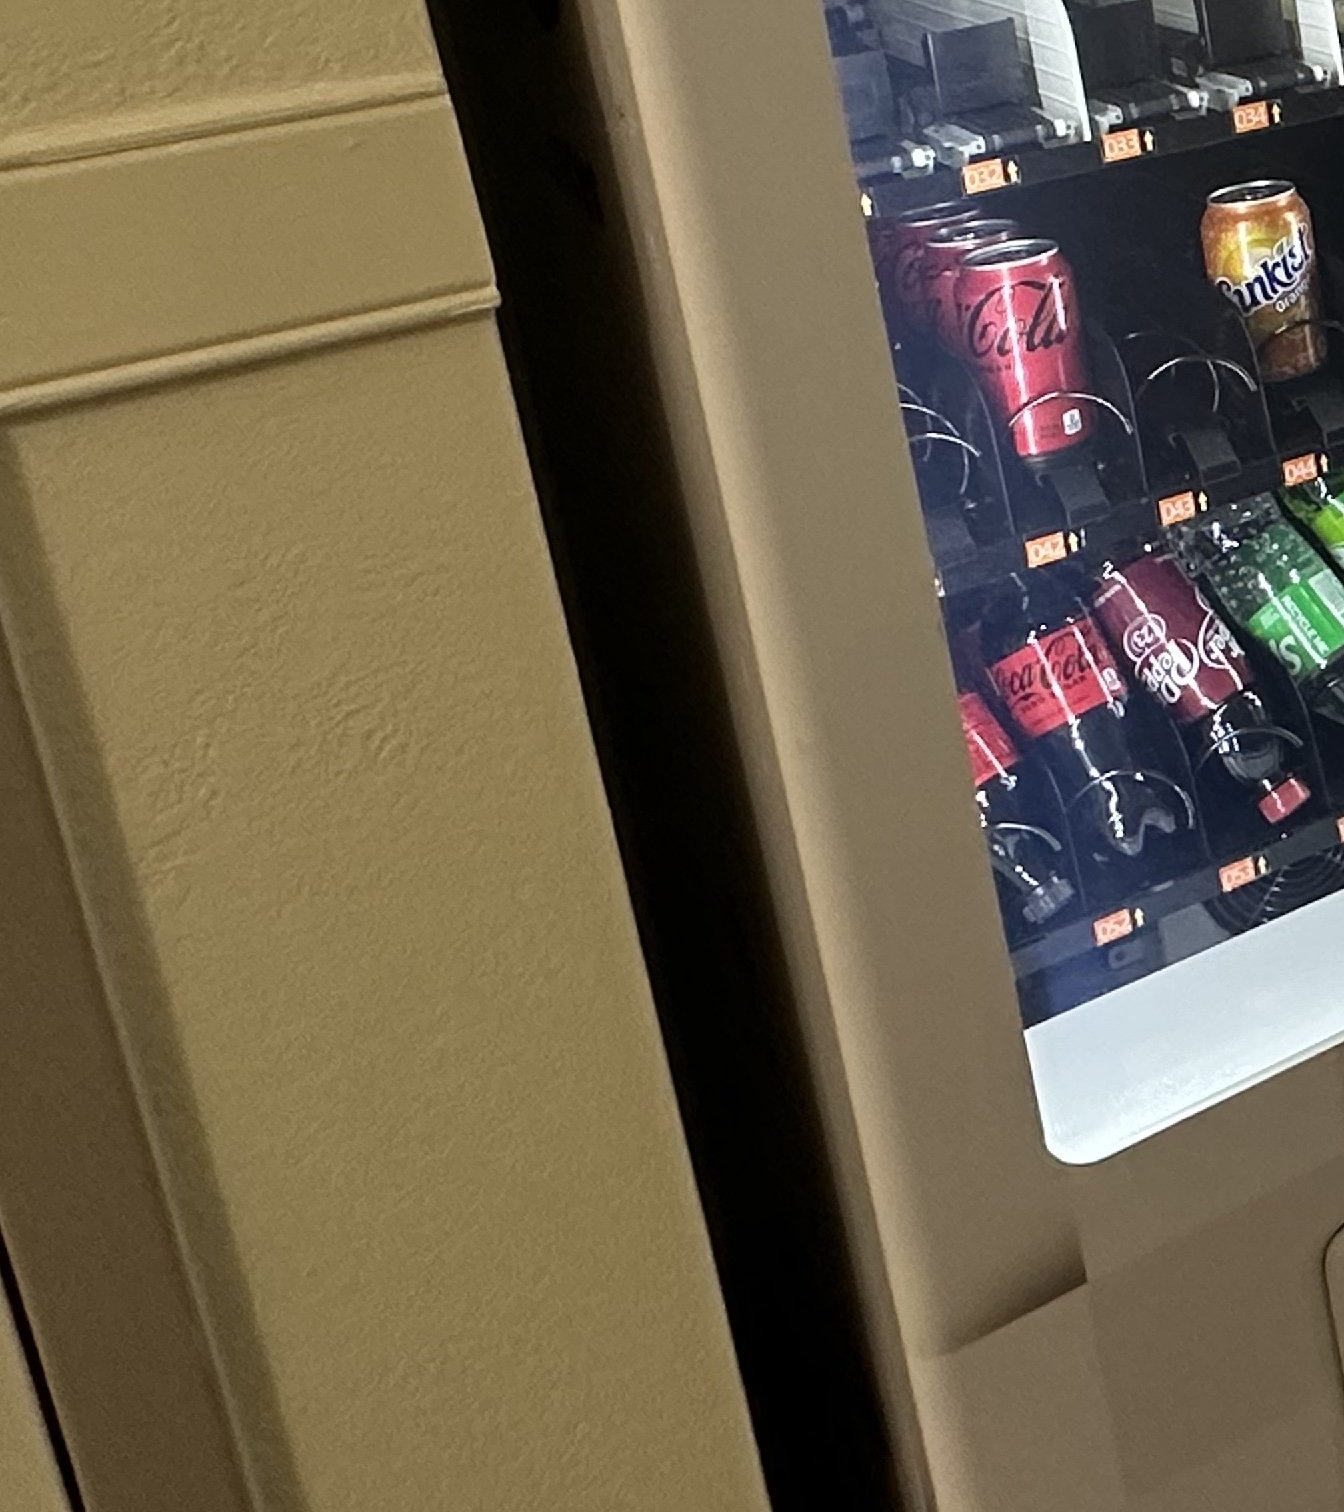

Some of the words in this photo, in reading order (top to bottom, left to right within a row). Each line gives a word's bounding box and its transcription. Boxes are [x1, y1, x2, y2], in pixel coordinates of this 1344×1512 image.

[1235, 106, 1267, 128] 034
[1104, 133, 1138, 158] 033
[967, 163, 1002, 187] 032
[1285, 458, 1317, 482] 044
[1162, 496, 1195, 521] 043
[1030, 536, 1066, 565] 042
